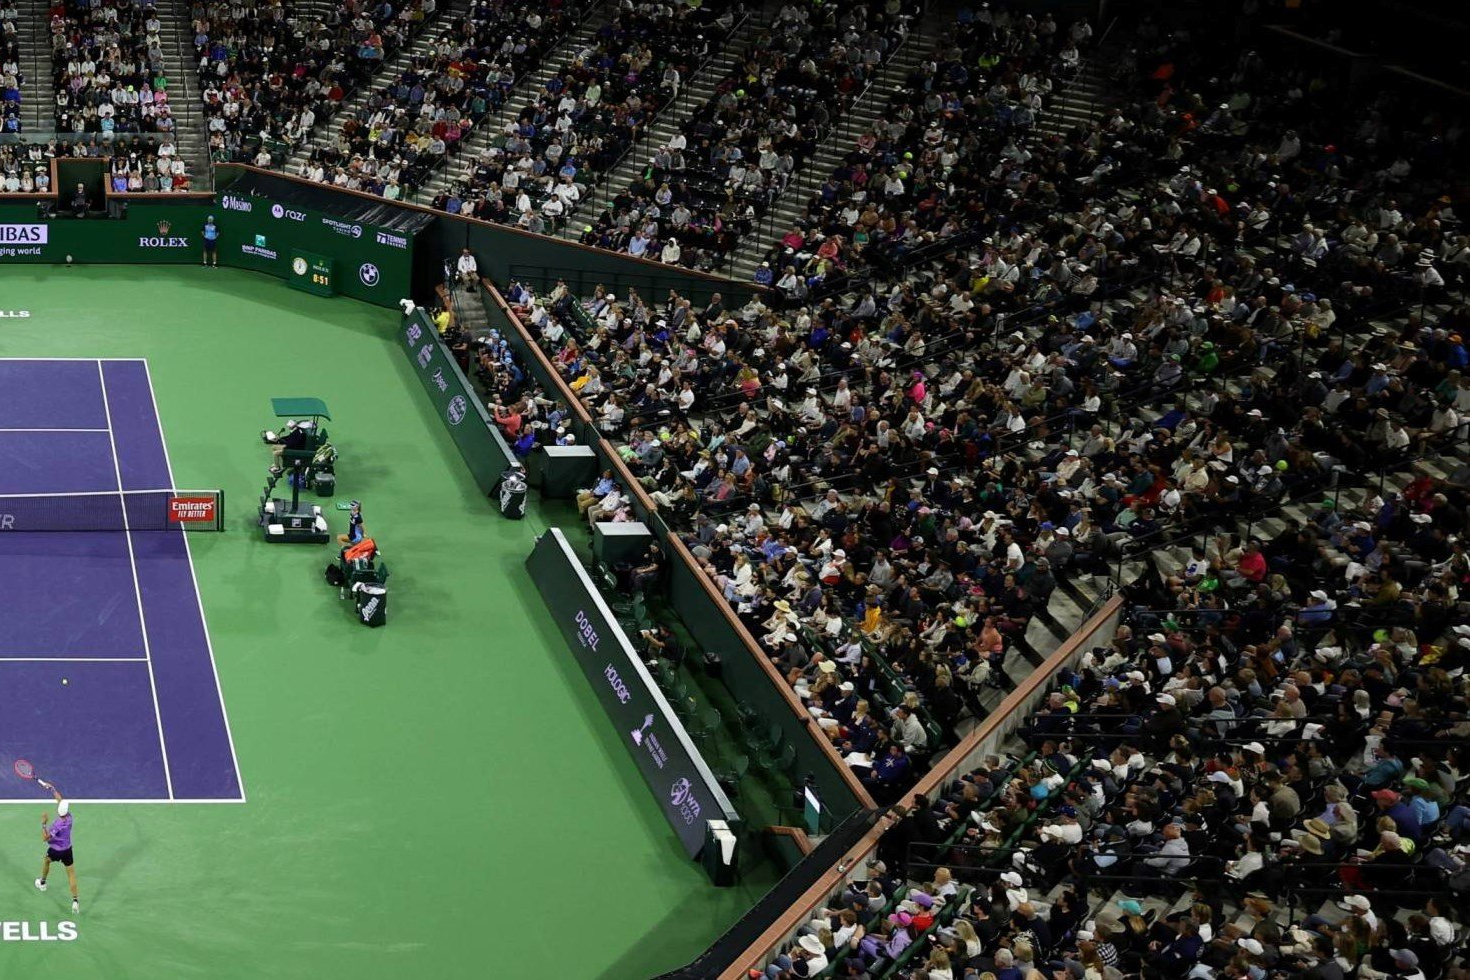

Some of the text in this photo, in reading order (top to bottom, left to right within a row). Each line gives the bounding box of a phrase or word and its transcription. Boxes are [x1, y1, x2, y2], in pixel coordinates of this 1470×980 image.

[285, 209, 307, 222] razr
[139, 237, 188, 247] ROLEX
[386, 234, 407, 245] TENNIS
[17, 247, 41, 255] world
[172, 502, 213, 511] Emirates
[575, 610, 600, 652] DOBEL
[604, 662, 632, 704] HOLOGIC
[686, 792, 701, 818] WTA
